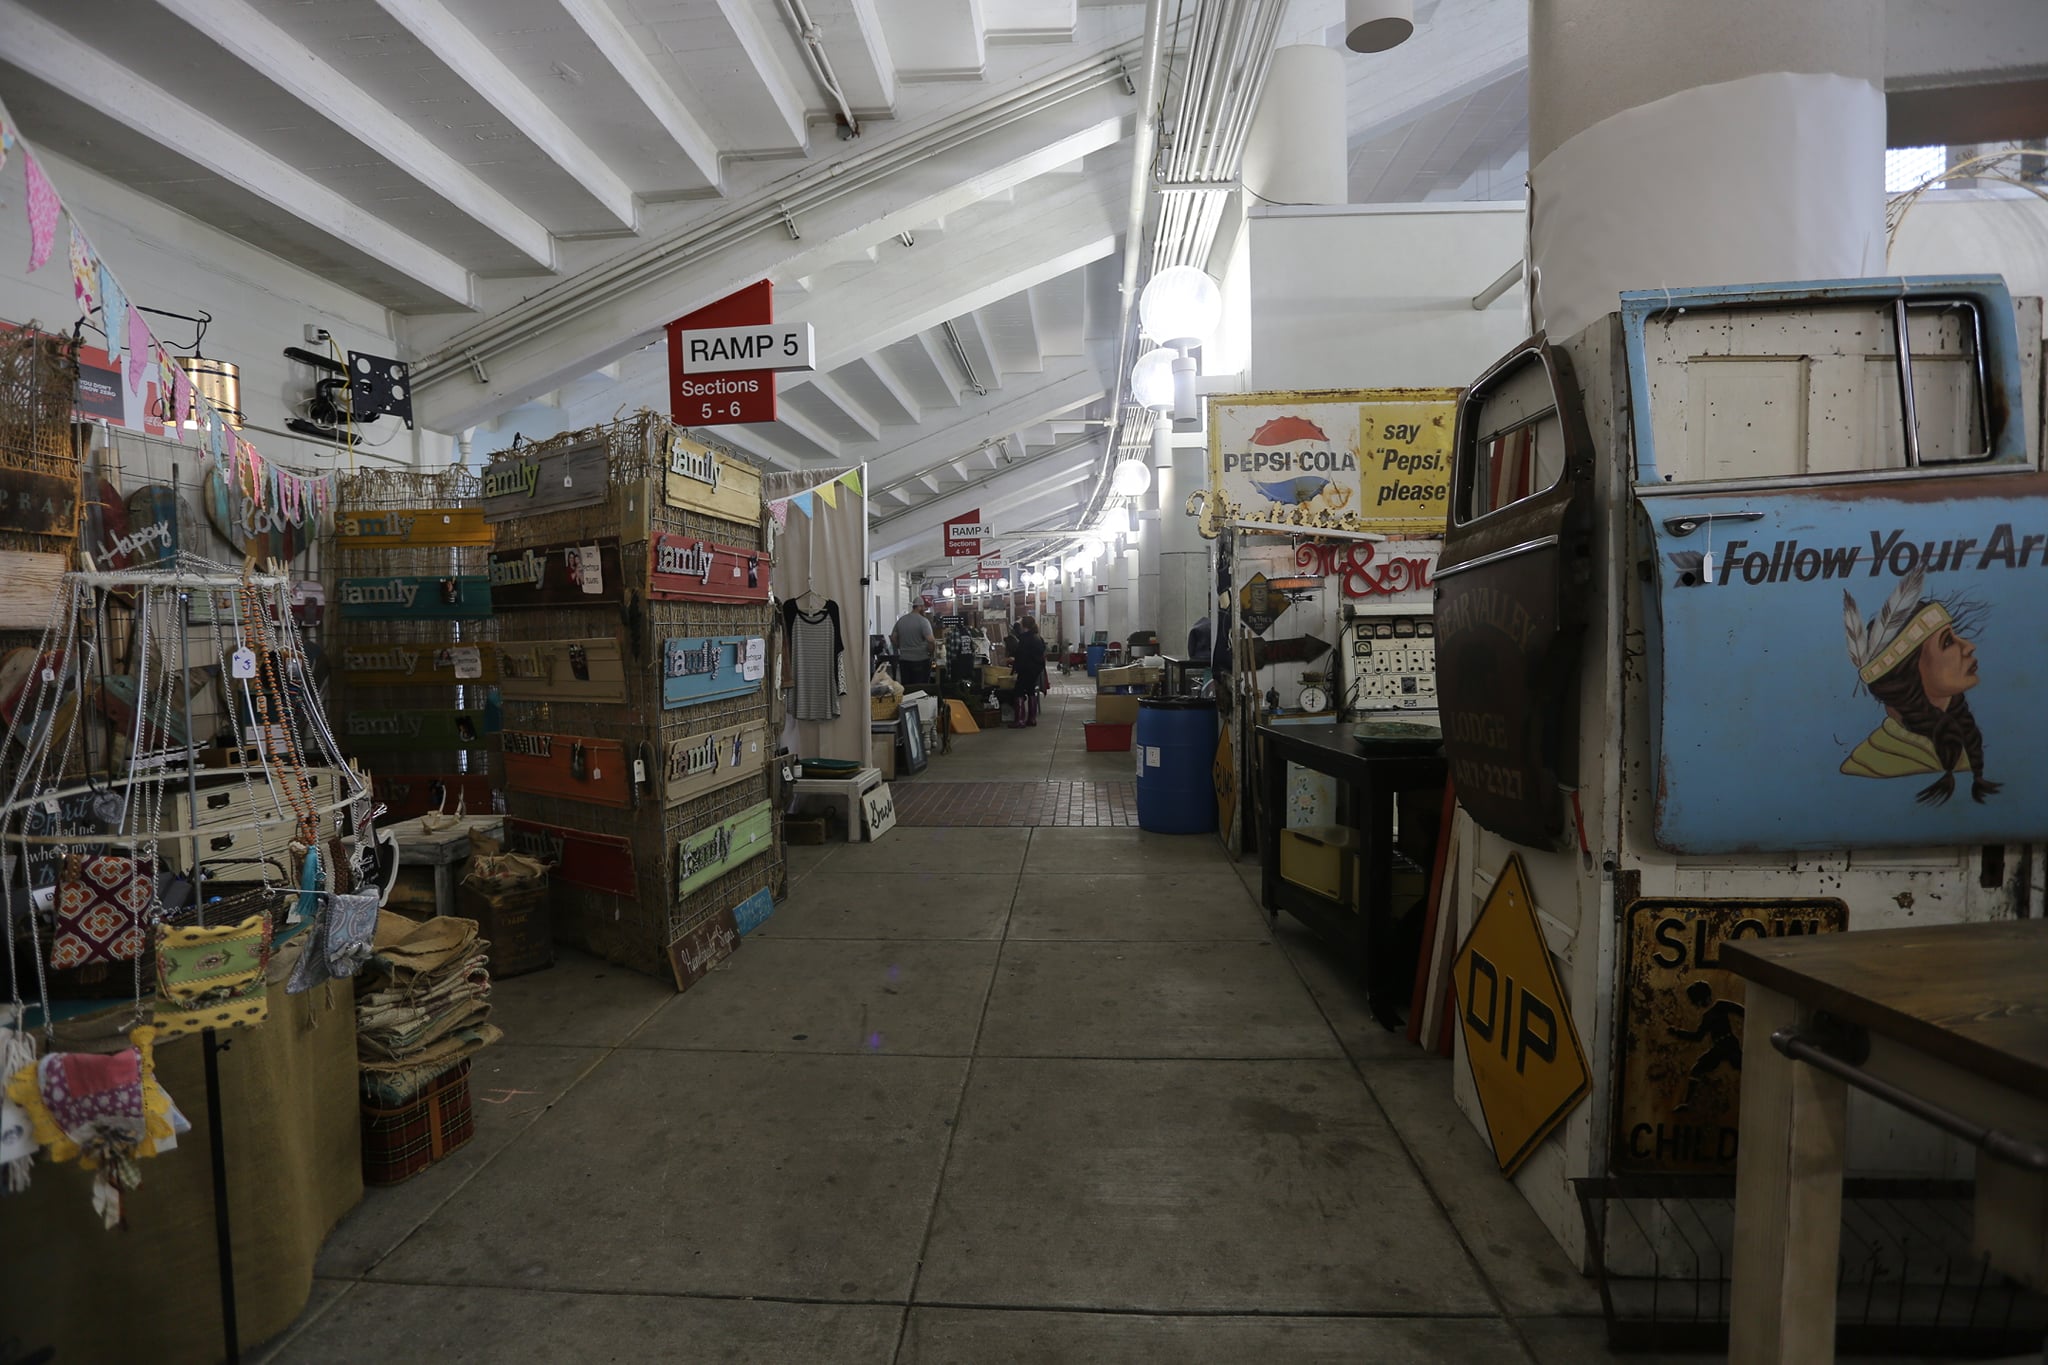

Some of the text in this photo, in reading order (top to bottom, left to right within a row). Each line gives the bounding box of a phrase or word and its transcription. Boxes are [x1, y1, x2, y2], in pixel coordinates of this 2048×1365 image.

[690, 333, 799, 363] RAMP 5
[99, 389, 117, 397] ZERO
[682, 378, 759, 397] Sections
[701, 403, 713, 419] 5
[730, 401, 741, 417] 6
[1383, 424, 1421, 445] say
[482, 457, 541, 499] family
[671, 436, 722, 494] family
[97, 519, 170, 568] Happy
[336, 512, 416, 542] family
[949, 540, 977, 548] Sections
[952, 526, 990, 536] RAMP 4
[488, 549, 549, 590] family
[657, 534, 714, 585] family
[1717, 539, 1861, 586] Follow
[1869, 529, 1977, 577] Your
[339, 579, 420, 608] family
[1472, 587, 1536, 654] VALLEY
[344, 647, 420, 677] family
[667, 639, 722, 681] family
[345, 710, 424, 736] family
[1451, 711, 1508, 750] LODGE
[669, 735, 723, 781] family
[51, 822, 96, 837] lad me
[29, 843, 69, 863] whee
[680, 822, 736, 880] family
[1653, 917, 1820, 970] SL
[1467, 949, 1557, 1078] DIP
[1630, 1123, 1738, 1161] CHILD
